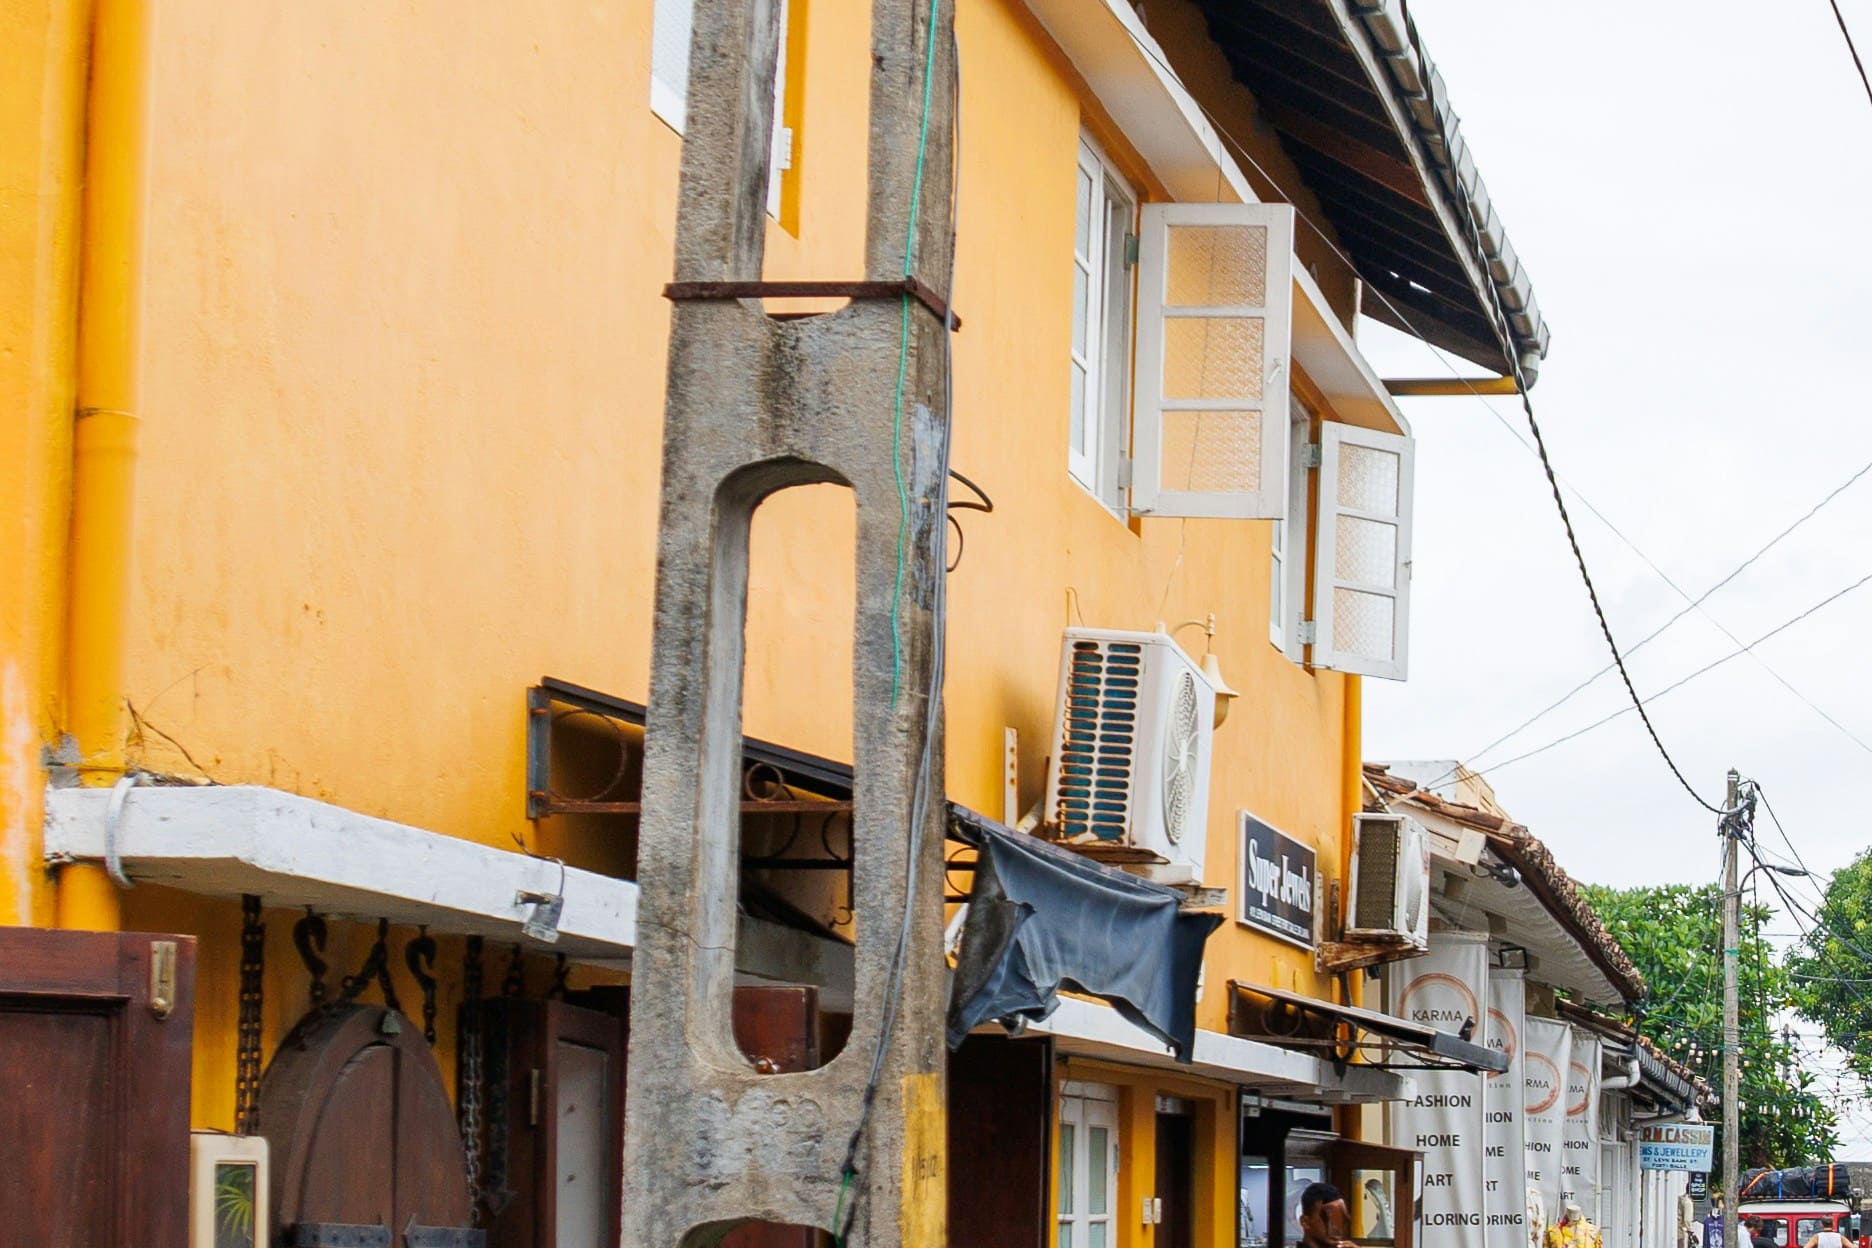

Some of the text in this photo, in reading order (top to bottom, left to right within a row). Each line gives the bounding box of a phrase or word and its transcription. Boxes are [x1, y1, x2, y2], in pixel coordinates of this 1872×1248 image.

[1248, 838, 1311, 912] Super Jewels
[1411, 1009, 1463, 1021] KARMA
[1416, 1134, 1460, 1147] HOME
[1660, 1147, 1708, 1158] JEWELLERY
[1424, 1174, 1453, 1186] ART
